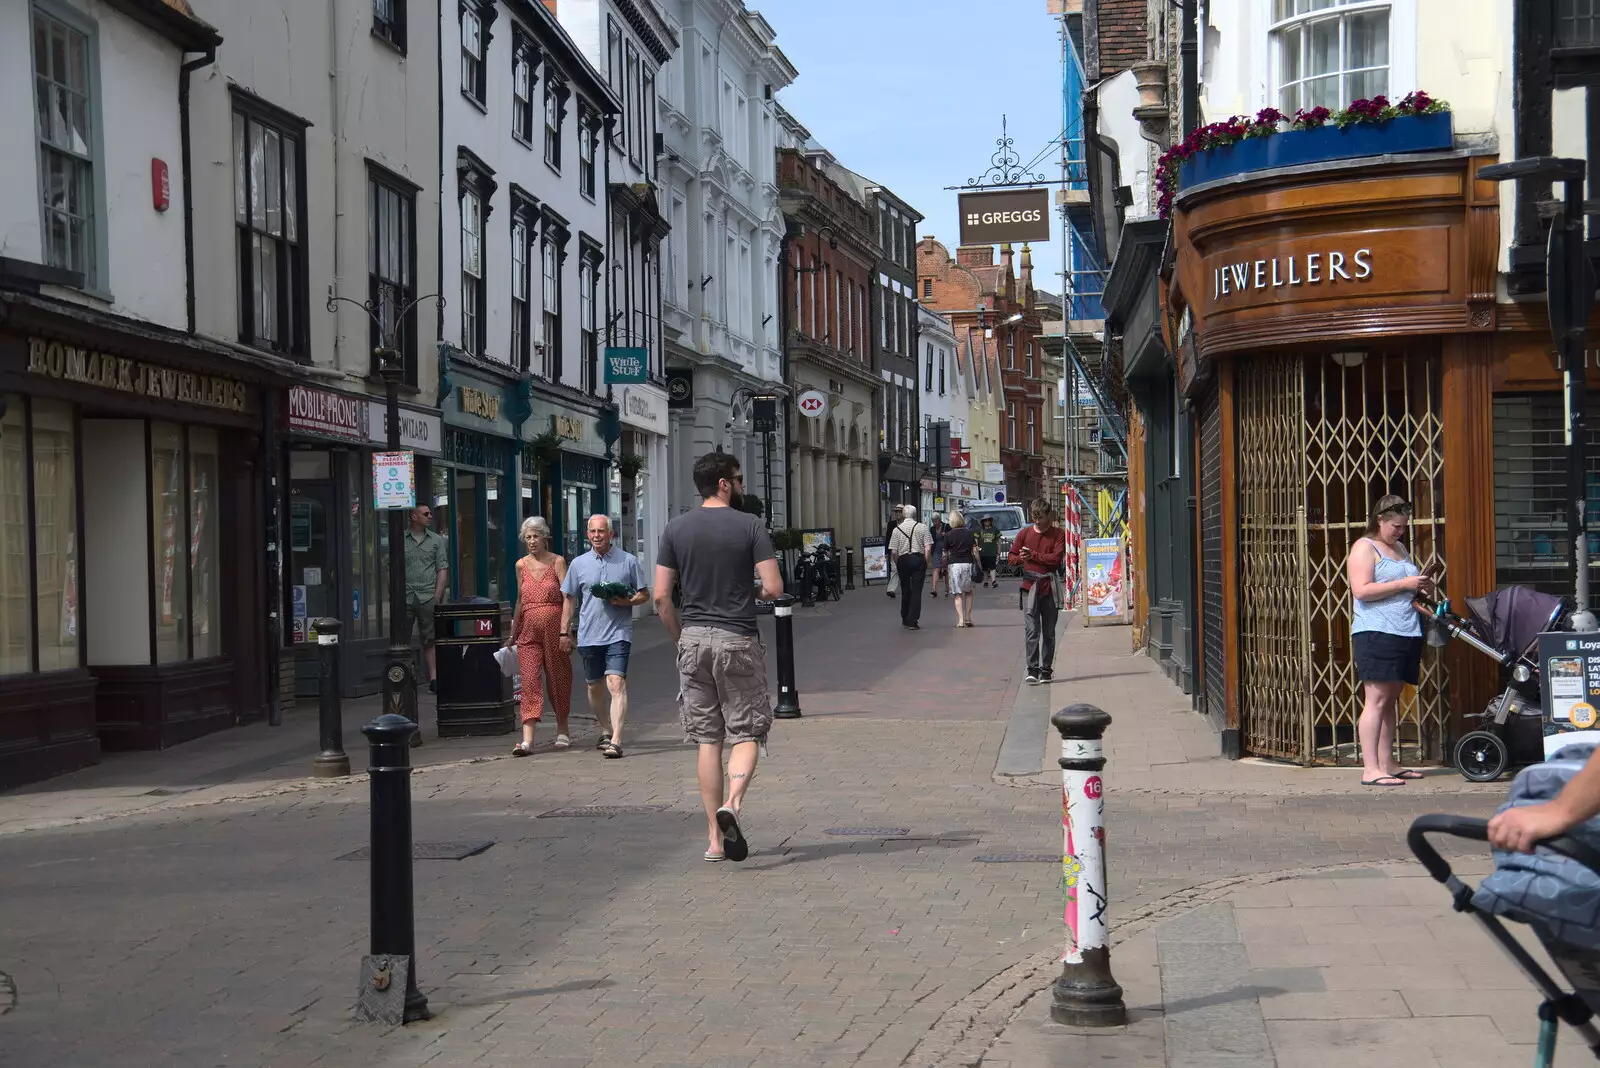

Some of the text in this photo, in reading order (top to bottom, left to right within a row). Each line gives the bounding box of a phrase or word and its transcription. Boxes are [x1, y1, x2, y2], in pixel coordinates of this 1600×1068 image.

[982, 209, 1041, 225] GREGGS
[1214, 248, 1372, 300] JEWELLERS
[134, 362, 247, 412] JEWELLERS
[289, 388, 326, 420] MOBILE
[328, 395, 357, 427] PHONE
[1086, 780, 1101, 794] 16
